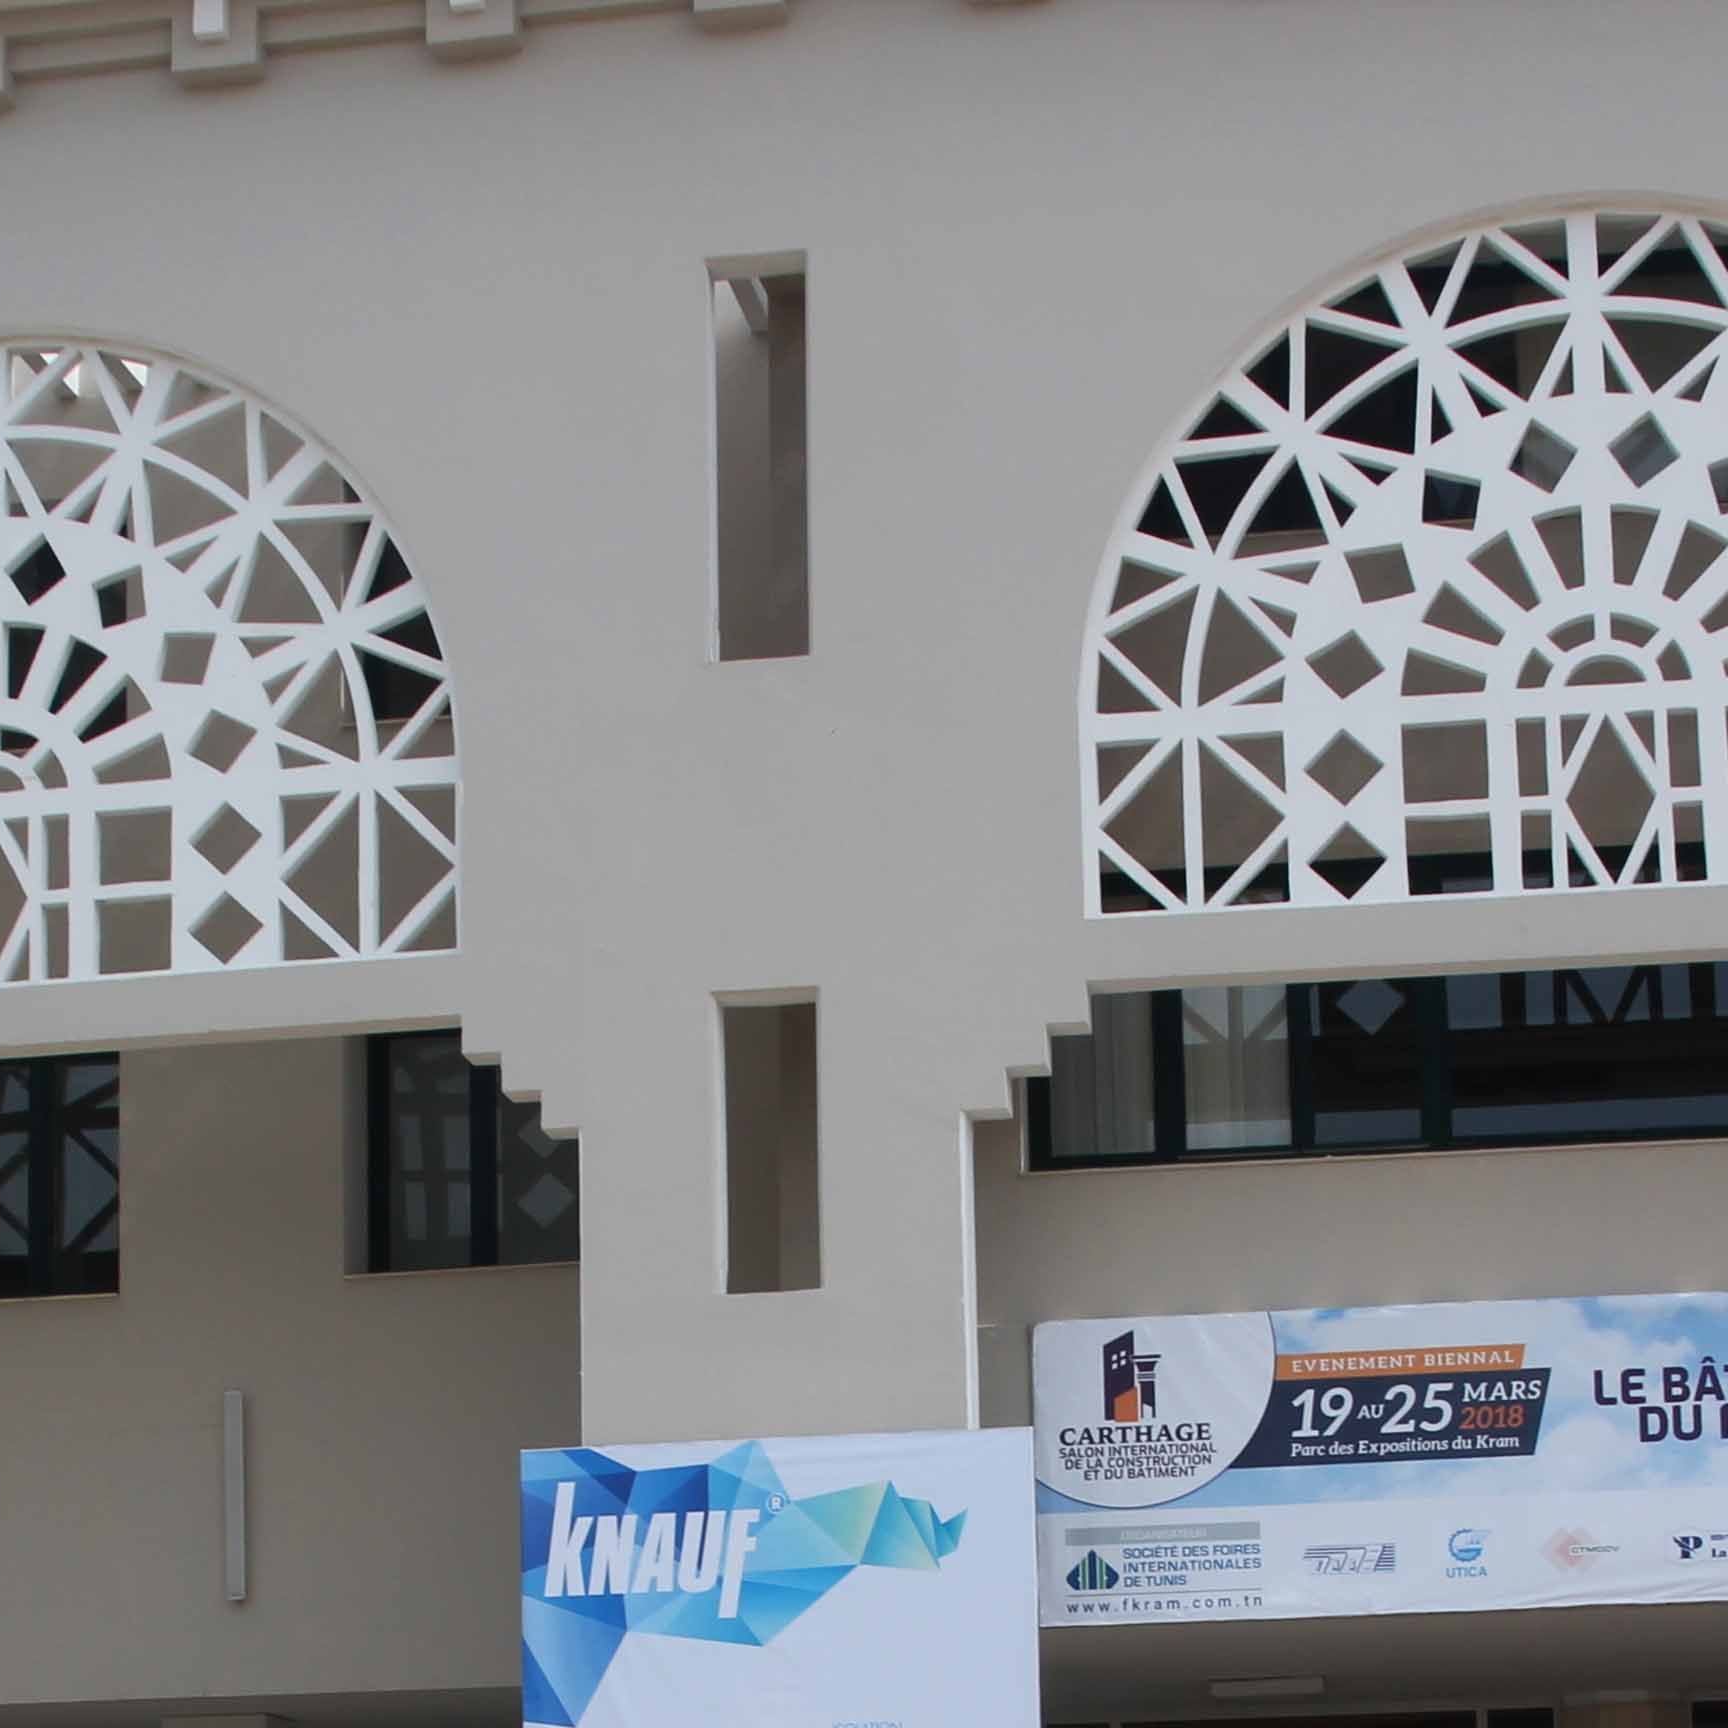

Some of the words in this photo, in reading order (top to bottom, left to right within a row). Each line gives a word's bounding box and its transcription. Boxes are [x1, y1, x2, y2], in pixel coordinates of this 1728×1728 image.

[1292, 1354, 1416, 1373] EVENEMENT
[1424, 1351, 1515, 1367] BIENNAL
[1594, 1368, 1645, 1405] LE
[1291, 1387, 1354, 1438] 19
[1357, 1404, 1384, 1419] AU
[1380, 1383, 1454, 1433] 25
[1462, 1380, 1541, 1402] MARS
[1459, 1405, 1524, 1430] 2018
[1638, 1404, 1703, 1442] DU
[1059, 1423, 1212, 1446] CARTHAGE
[1059, 1447, 1105, 1459] SALON
[1109, 1443, 1216, 1456] INTERNATIONAL
[1291, 1443, 1325, 1457] Parc
[1328, 1440, 1354, 1455] des
[1358, 1437, 1449, 1457] Expositions
[1452, 1436, 1472, 1450] du
[1476, 1434, 1519, 1449] Kram
[1065, 1459, 1082, 1470] DE
[1087, 1458, 1103, 1469] LA
[1108, 1454, 1212, 1468] CONSTRUCTION
[1084, 1470, 1100, 1480] ET
[1104, 1469, 1123, 1480] DU
[1128, 1466, 1196, 1479] BATIMENT
[544, 1481, 761, 1619] KNAUF
[1123, 1545, 1179, 1559] SOCIÉTÉ
[1183, 1545, 1209, 1557] DES
[1213, 1544, 1260, 1556] FOIRES
[1711, 1547, 1727, 1559] La
[1123, 1558, 1262, 1573] INTERNATIONALES
[1446, 1566, 1488, 1579] UTICA
[1124, 1576, 1142, 1588] DE
[1145, 1575, 1187, 1586] TUNIS
[1066, 1595, 1263, 1613] www.fkram.com.tn
